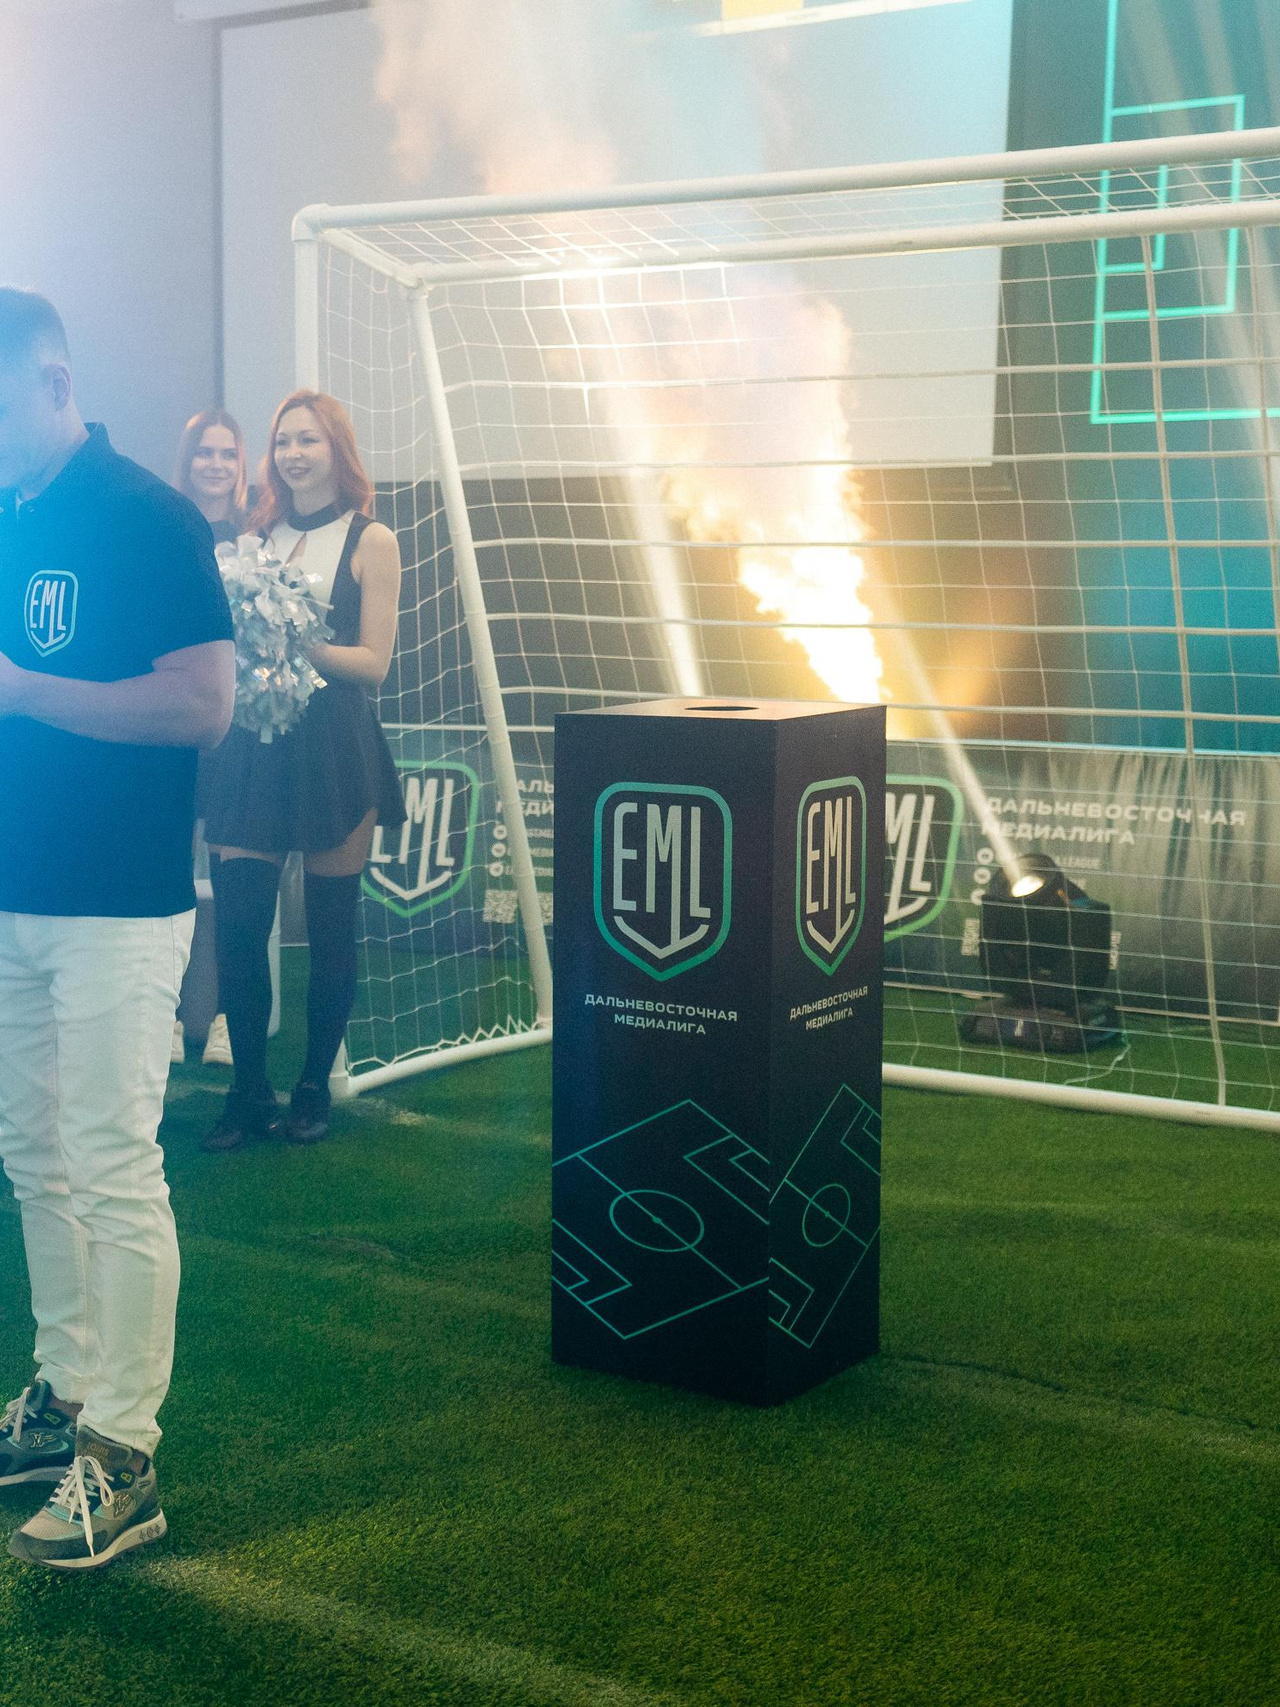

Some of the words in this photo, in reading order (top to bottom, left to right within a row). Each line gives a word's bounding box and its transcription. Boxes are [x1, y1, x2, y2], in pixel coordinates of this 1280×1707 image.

[29, 579, 67, 650] EML
[613, 801, 712, 960] EML
[806, 795, 857, 954] EML
[584, 993, 738, 1022] ДАЛЬНЕВОСТОЧНАЯ
[789, 985, 869, 1021] ДАЛЬНЕВОСТОЧНАЯ
[805, 1006, 854, 1031] МЕДИАЛИГА
[613, 1013, 707, 1036] МЕДИАЛИГА
